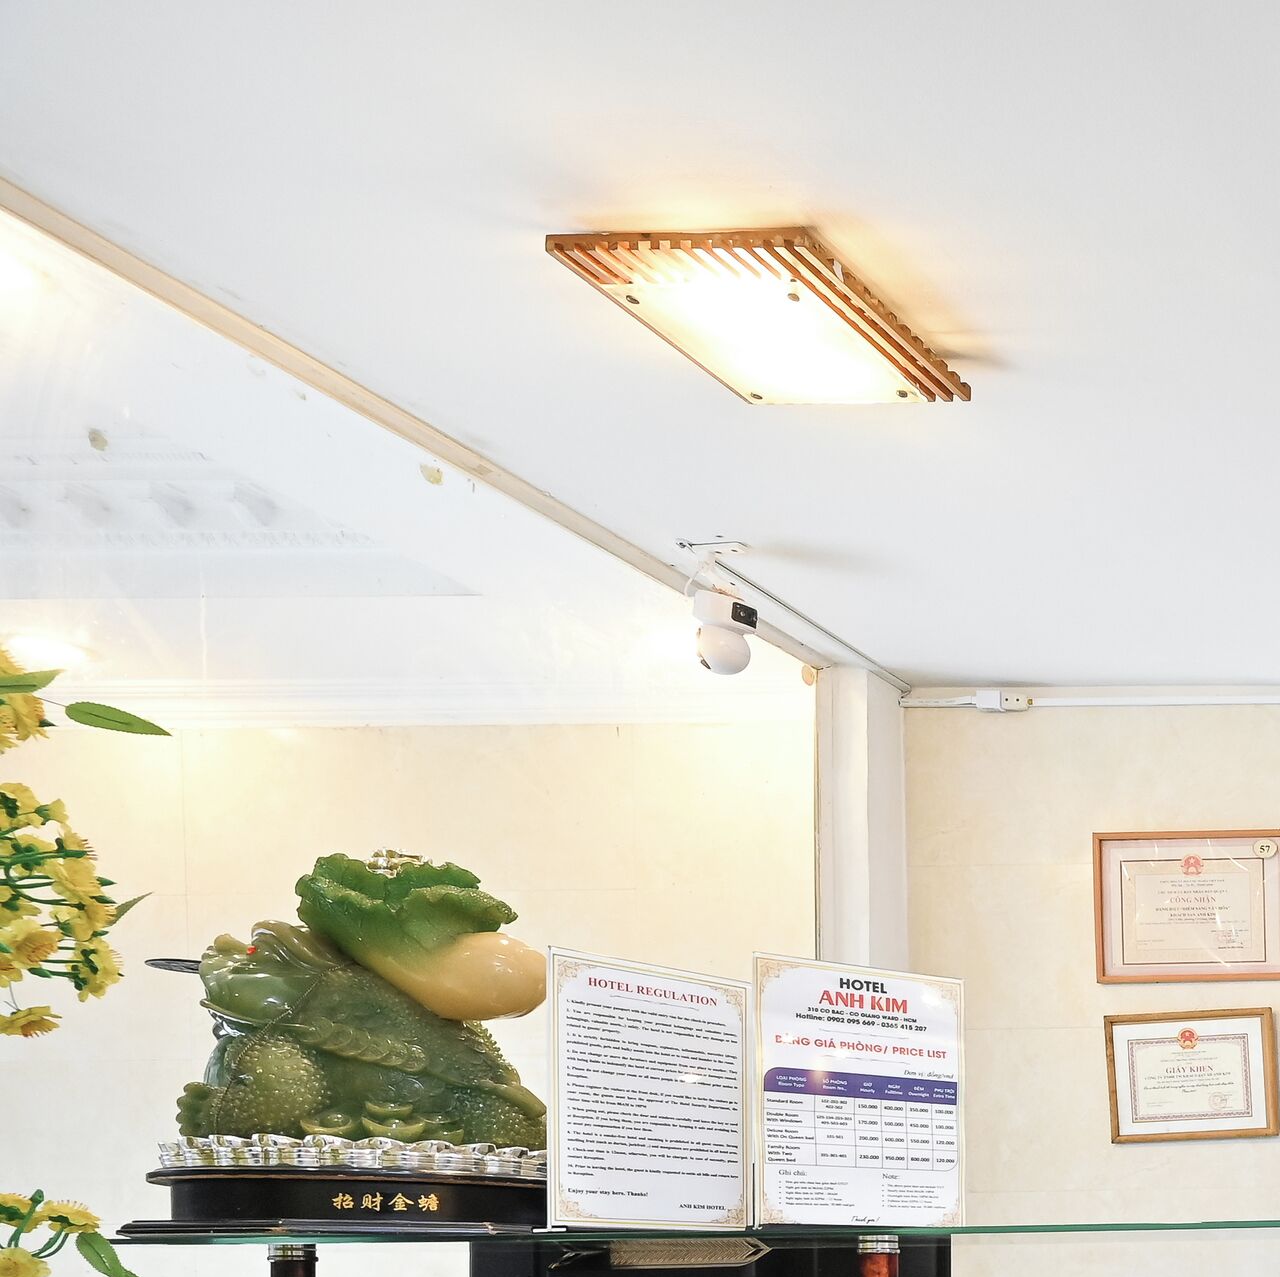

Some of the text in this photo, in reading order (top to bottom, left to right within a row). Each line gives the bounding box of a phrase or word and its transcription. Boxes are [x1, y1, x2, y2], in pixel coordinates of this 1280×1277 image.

[1260, 845, 1270, 853] 57
[1194, 896, 1216, 904] NHẬN
[588, 977, 717, 1006] HOTEL REGULATION
[840, 978, 887, 993] HOTEL
[819, 990, 907, 1014] ANH KIM
[796, 1013, 825, 1021] Hotline:
[775, 1033, 810, 1045] BNG
[814, 1038, 836, 1048] GIÁ
[893, 1046, 923, 1056] PRICE
[927, 1050, 946, 1059] LIST
[332, 1192, 439, 1211] 招财金蟾
